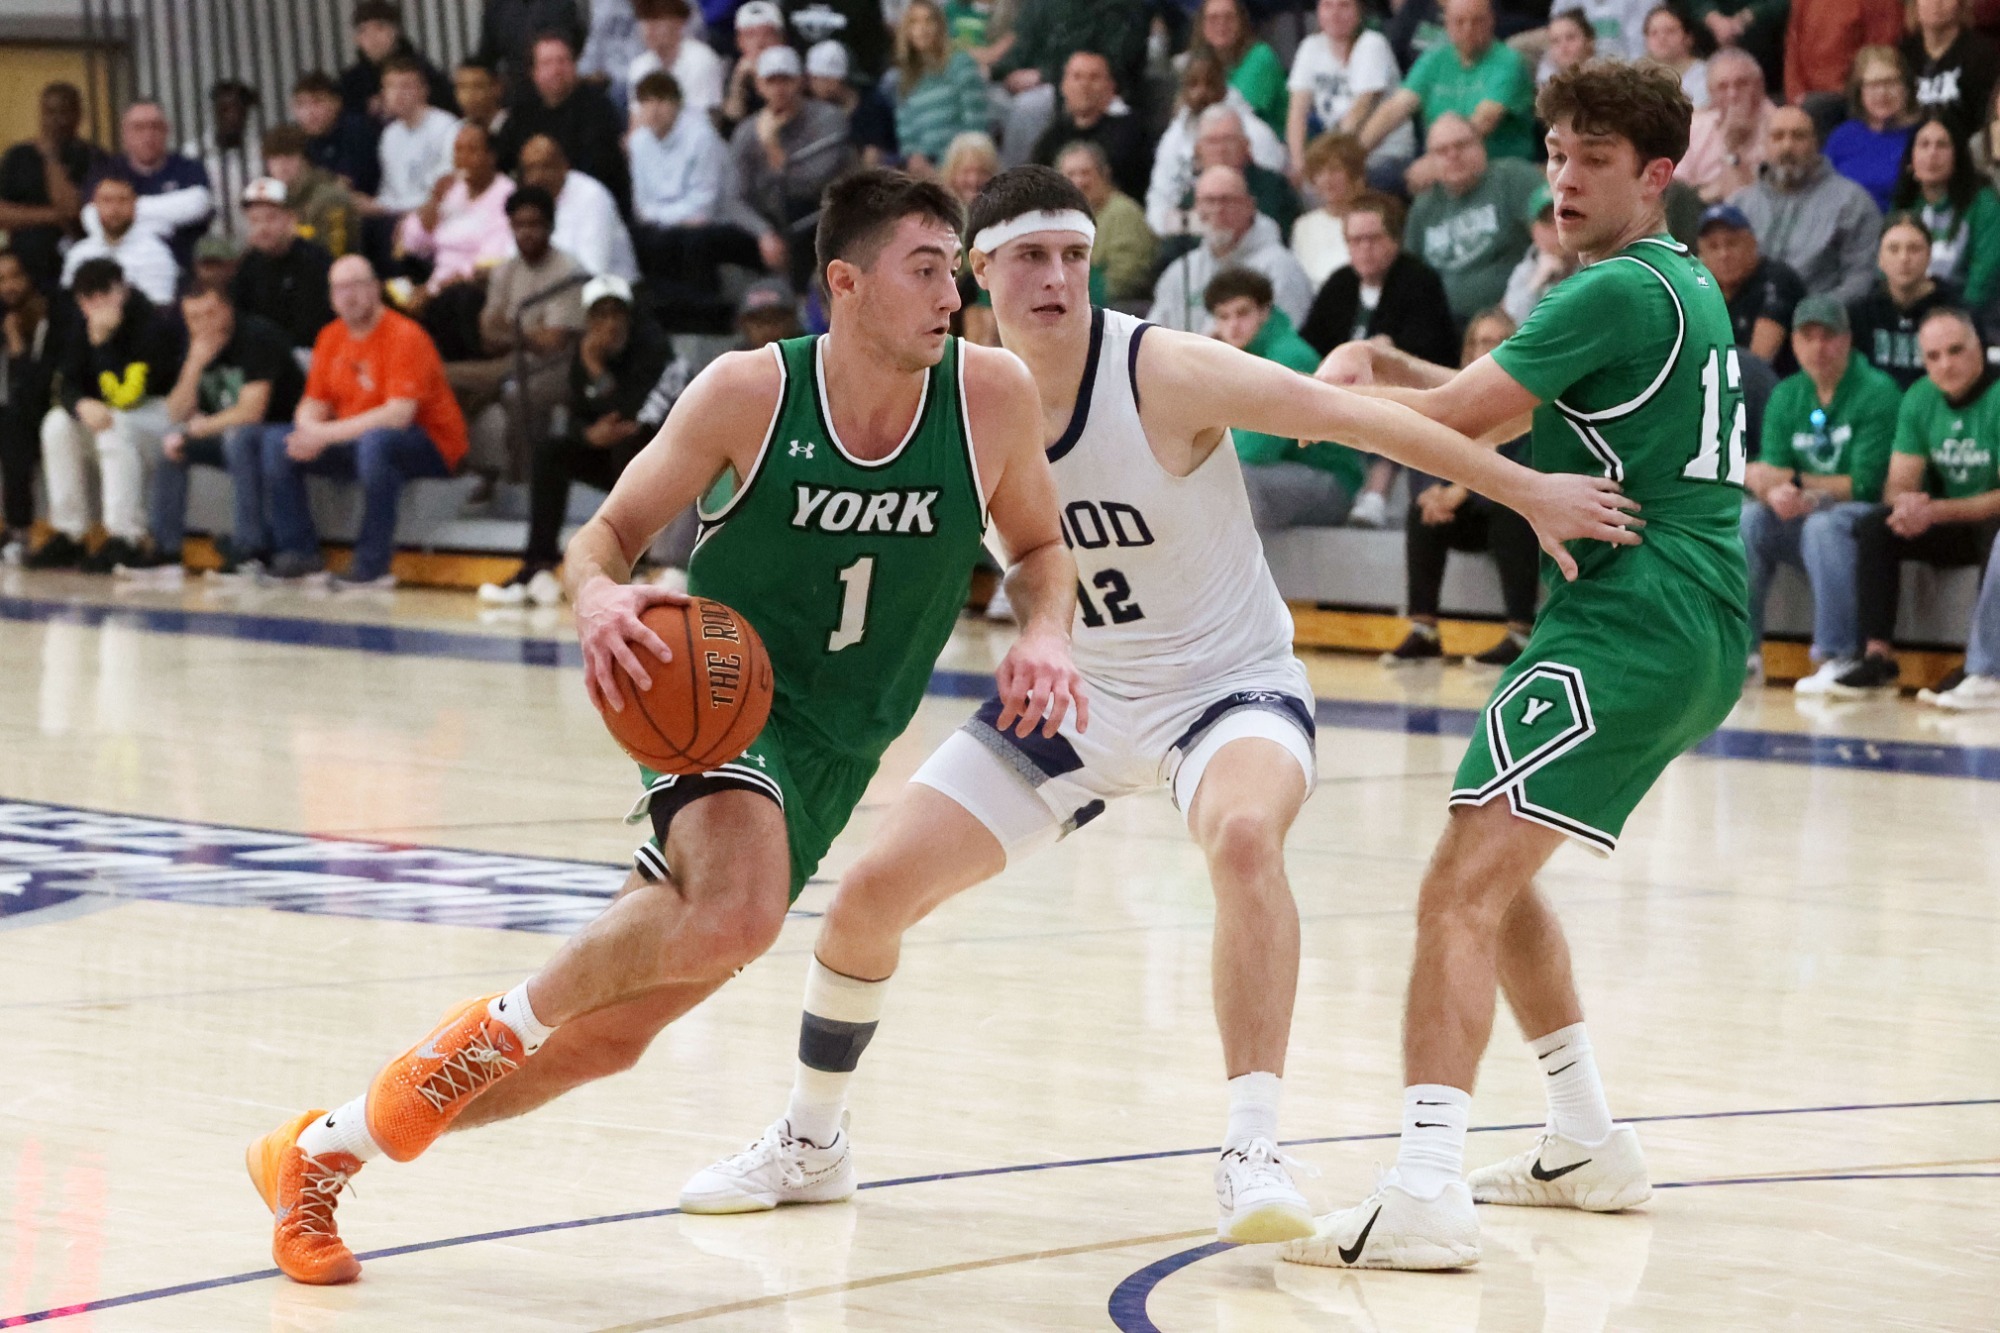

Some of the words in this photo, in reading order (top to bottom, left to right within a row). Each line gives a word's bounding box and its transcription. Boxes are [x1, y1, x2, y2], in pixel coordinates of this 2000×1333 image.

[791, 485, 939, 533] YORK
[1059, 500, 1155, 550] OD
[699, 600, 741, 645] ROC
[828, 557, 874, 652] 1
[1076, 568, 1146, 628] 12
[704, 650, 742, 709] THE
[1520, 697, 1554, 726] Y
